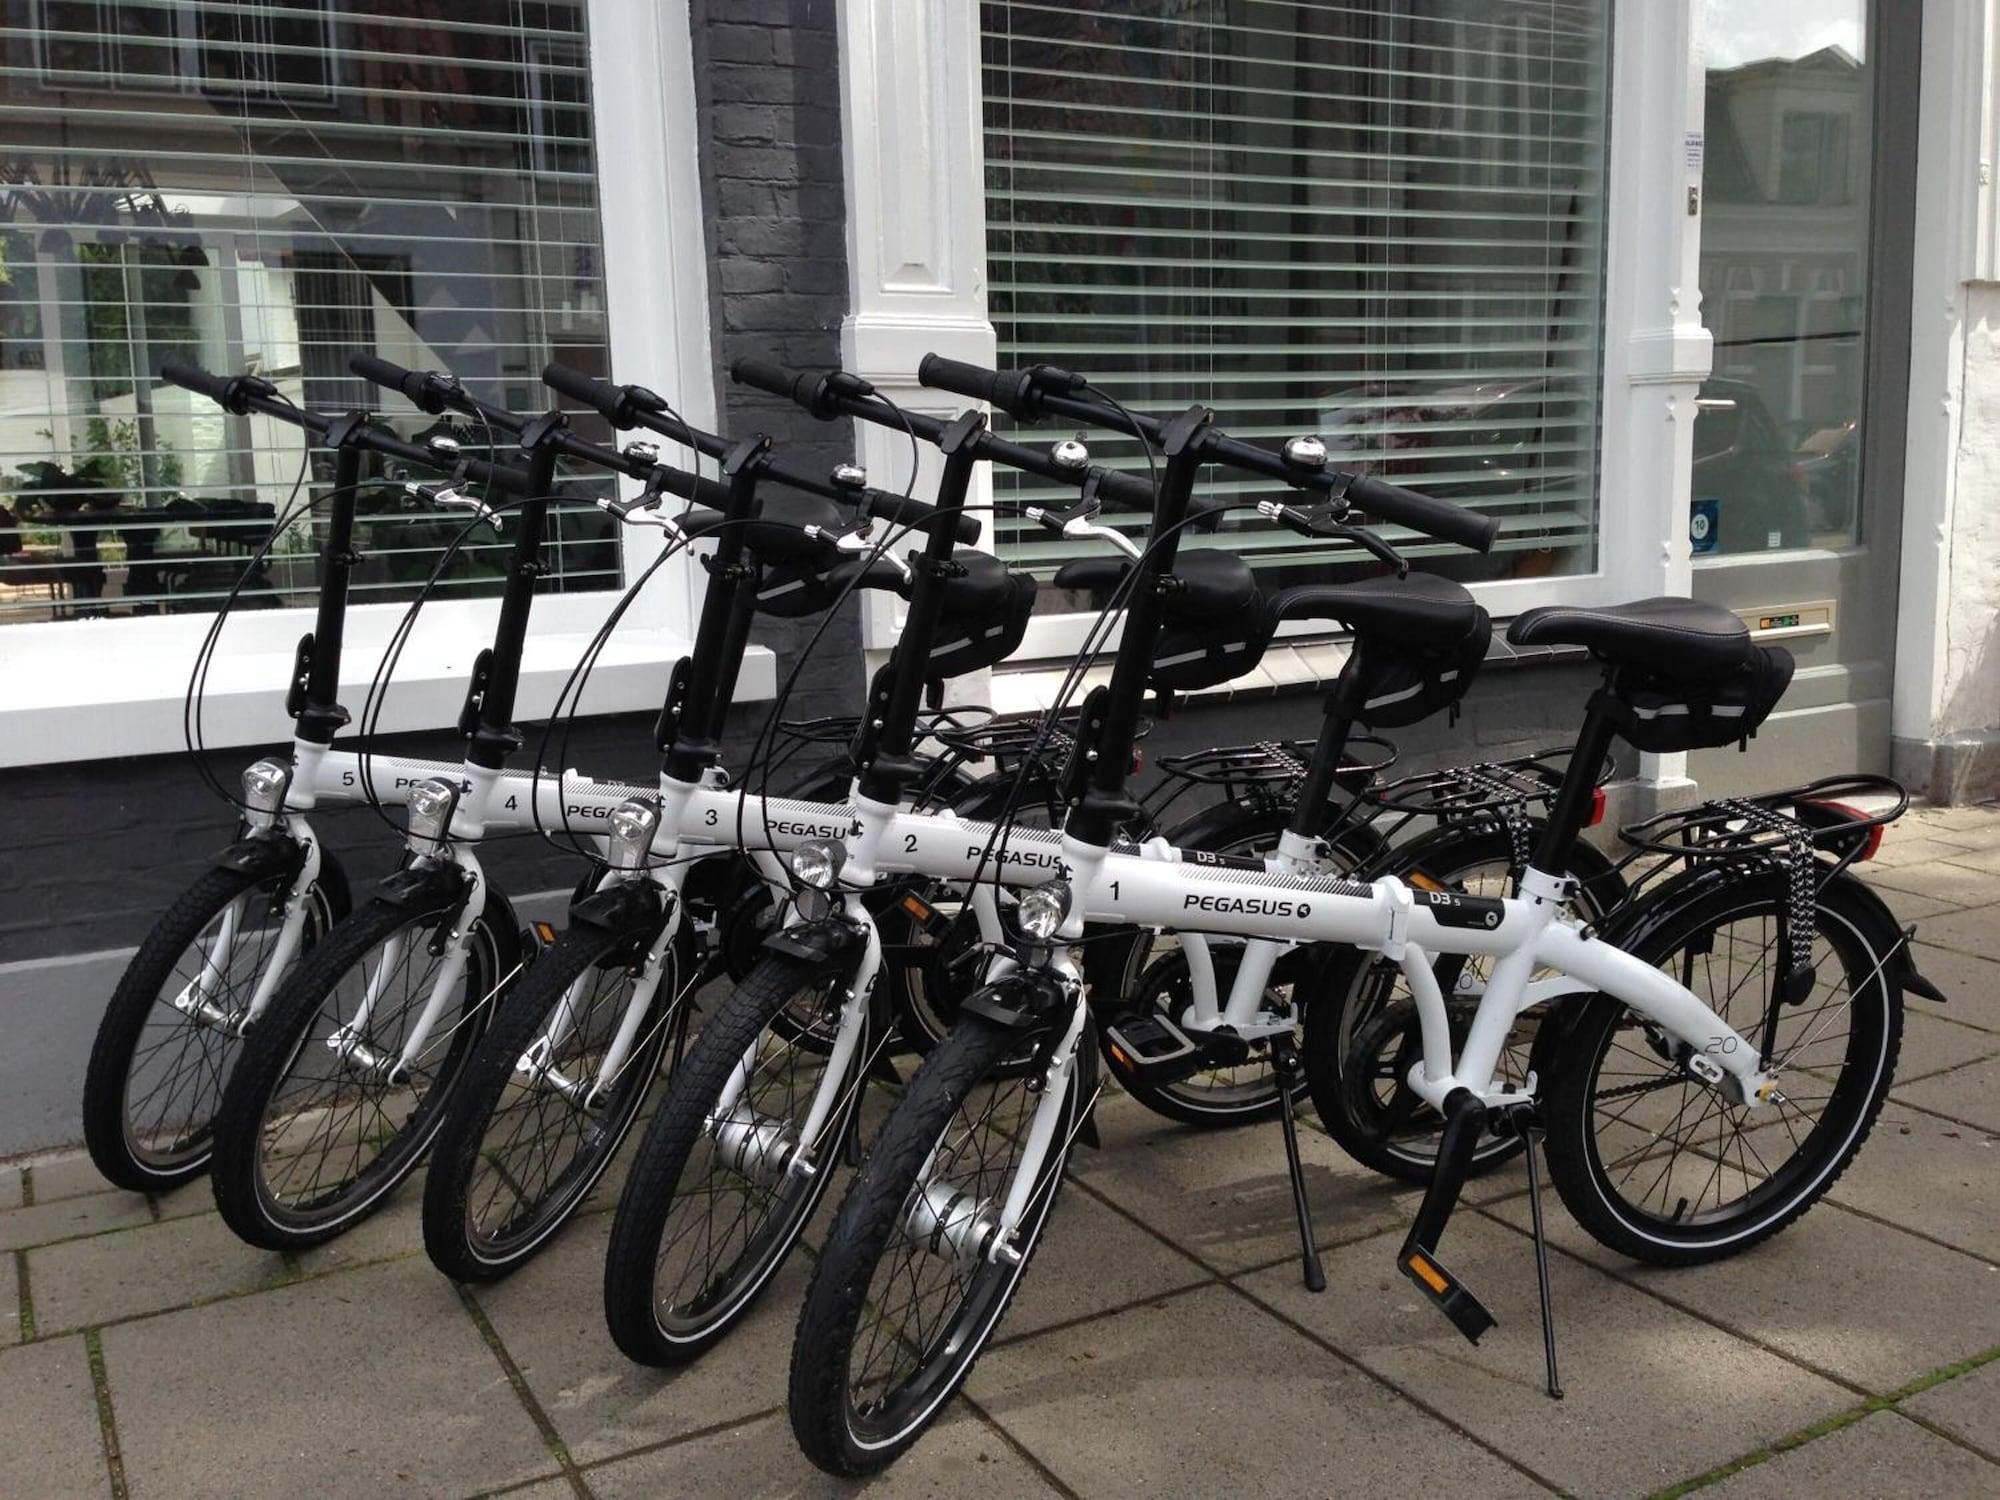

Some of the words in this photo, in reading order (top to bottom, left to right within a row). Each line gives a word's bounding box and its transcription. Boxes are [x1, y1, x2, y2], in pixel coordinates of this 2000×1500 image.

[1695, 519, 1705, 531] 10
[342, 771, 355, 786] 5
[504, 795, 518, 811] 4
[704, 808, 718, 826] 3
[765, 820, 847, 840] PEGASU
[904, 833, 919, 853] 2
[1196, 850, 1217, 864] D3
[1109, 880, 1120, 901] 1
[1429, 891, 1452, 905] D3
[1183, 894, 1293, 917] PEGASUS
[1704, 1036, 1738, 1054] 20
